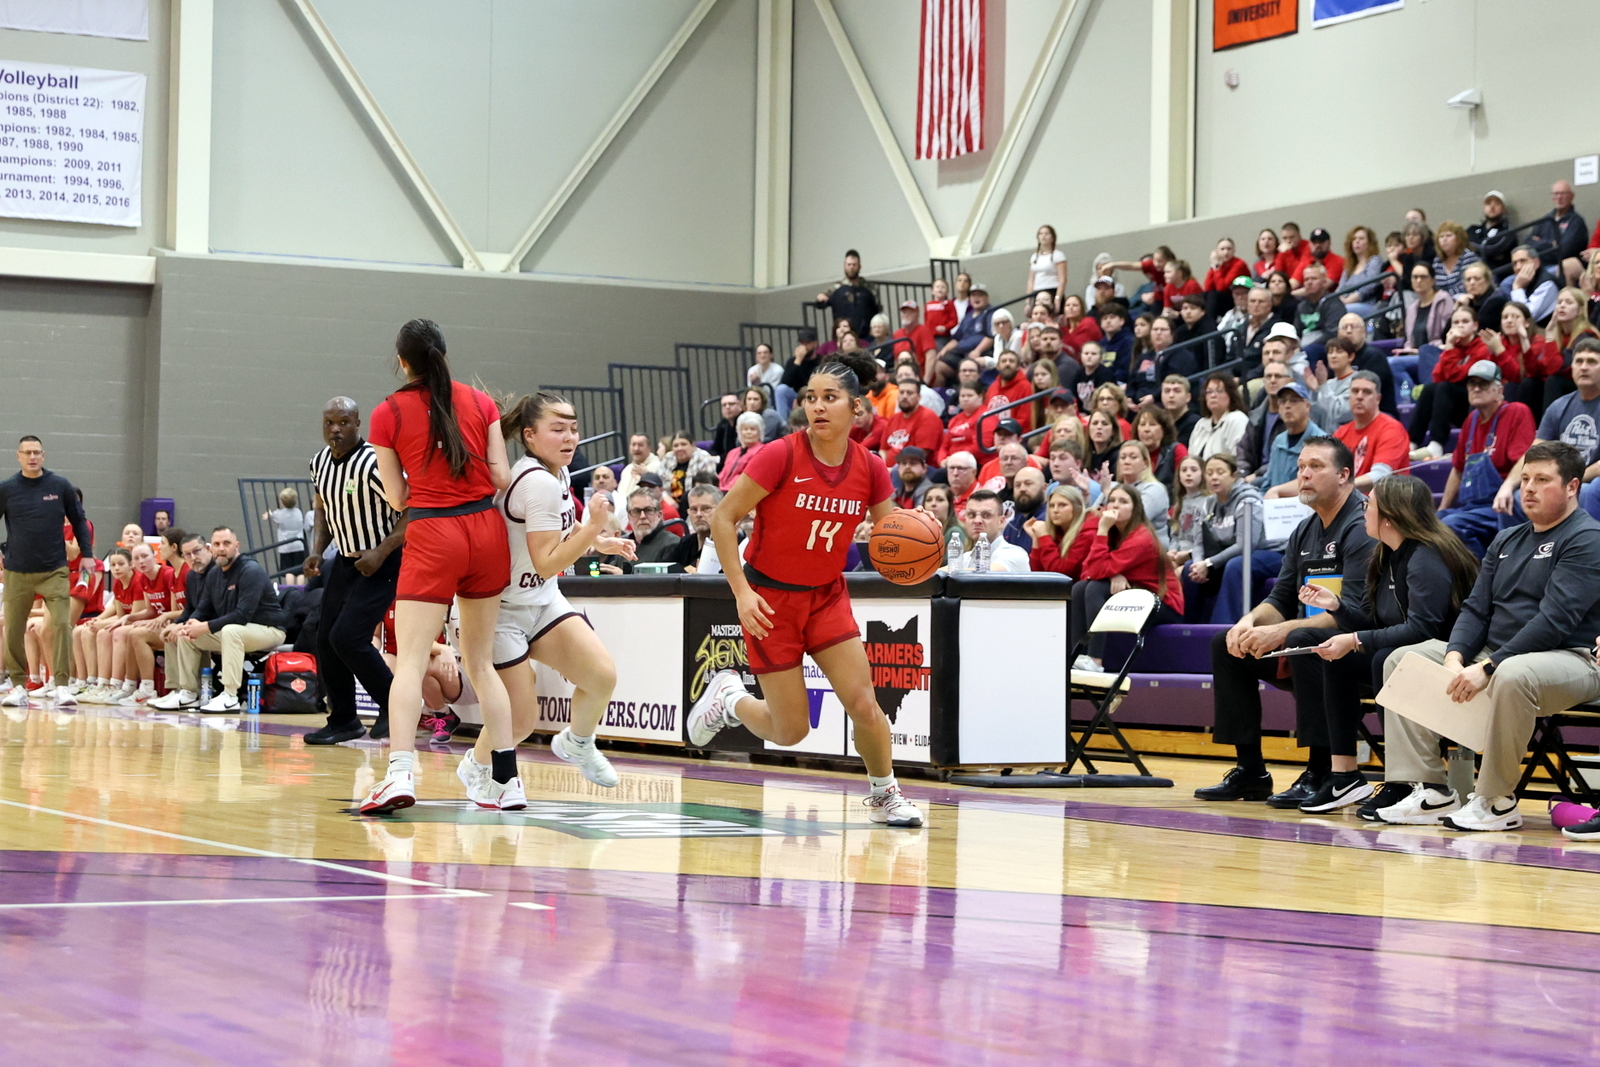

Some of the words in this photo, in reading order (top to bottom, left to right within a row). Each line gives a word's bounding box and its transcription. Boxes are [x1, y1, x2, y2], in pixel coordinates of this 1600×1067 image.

[1227, 0, 1280, 25] UNIVERSITY
[6, 105, 35, 118] 1985,
[41, 108, 66, 119] 1988
[33, 93, 79, 106] (District
[83, 97, 103, 110] 22):
[112, 100, 139, 112] 1982,
[46, 125, 75, 138] 1982,
[80, 128, 108, 141] 1984,
[112, 131, 140, 144] 1985,
[0, 137, 18, 149] 87,
[23, 138, 53, 151] 1988,
[57, 141, 83, 152] 1990
[0, 155, 56, 167] ampions:
[64, 158, 93, 171] 2009,
[97, 161, 121, 172] 2011
[64, 175, 92, 188] 1994,
[97, 178, 124, 191] 1996,
[5, 188, 35, 200] 2013,
[39, 190, 69, 203] 2014,
[73, 193, 101, 206] 2015,
[105, 195, 130, 207] 2016
[795, 493, 861, 516] BELLEVUE
[806, 519, 843, 553] 14
[1104, 604, 1146, 612] BLUFFTON
[863, 641, 924, 666] ARMERS
